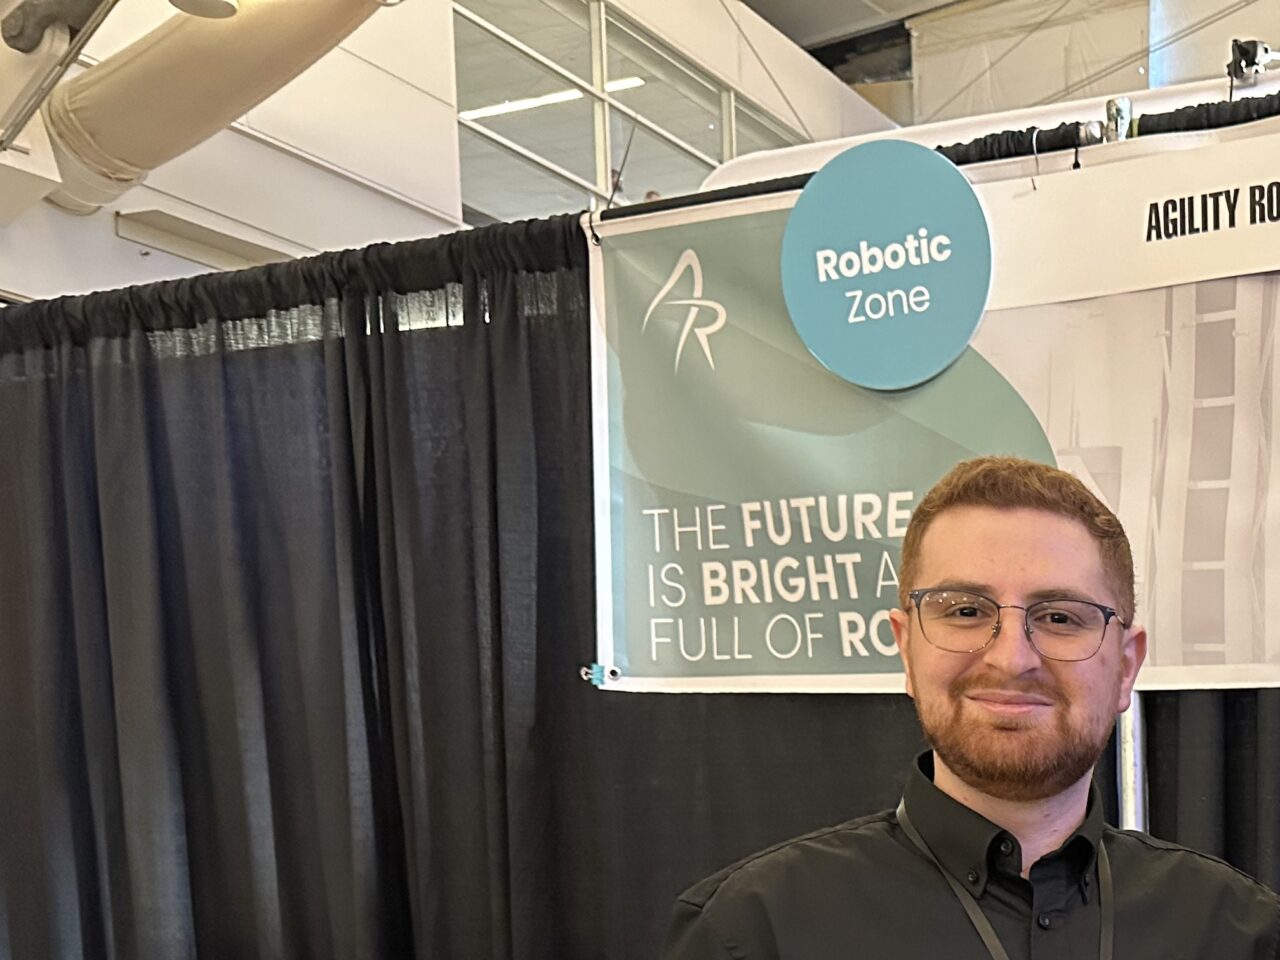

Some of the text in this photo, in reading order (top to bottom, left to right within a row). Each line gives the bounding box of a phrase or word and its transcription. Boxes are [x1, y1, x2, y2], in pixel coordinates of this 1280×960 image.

[1146, 188, 1240, 242] AGILITY
[816, 227, 952, 282] Robotic
[844, 285, 930, 323] Zone
[642, 491, 914, 552] THE FUTURE
[648, 551, 900, 607] IS BRIGHT A
[650, 609, 901, 661] FULL OF RO
